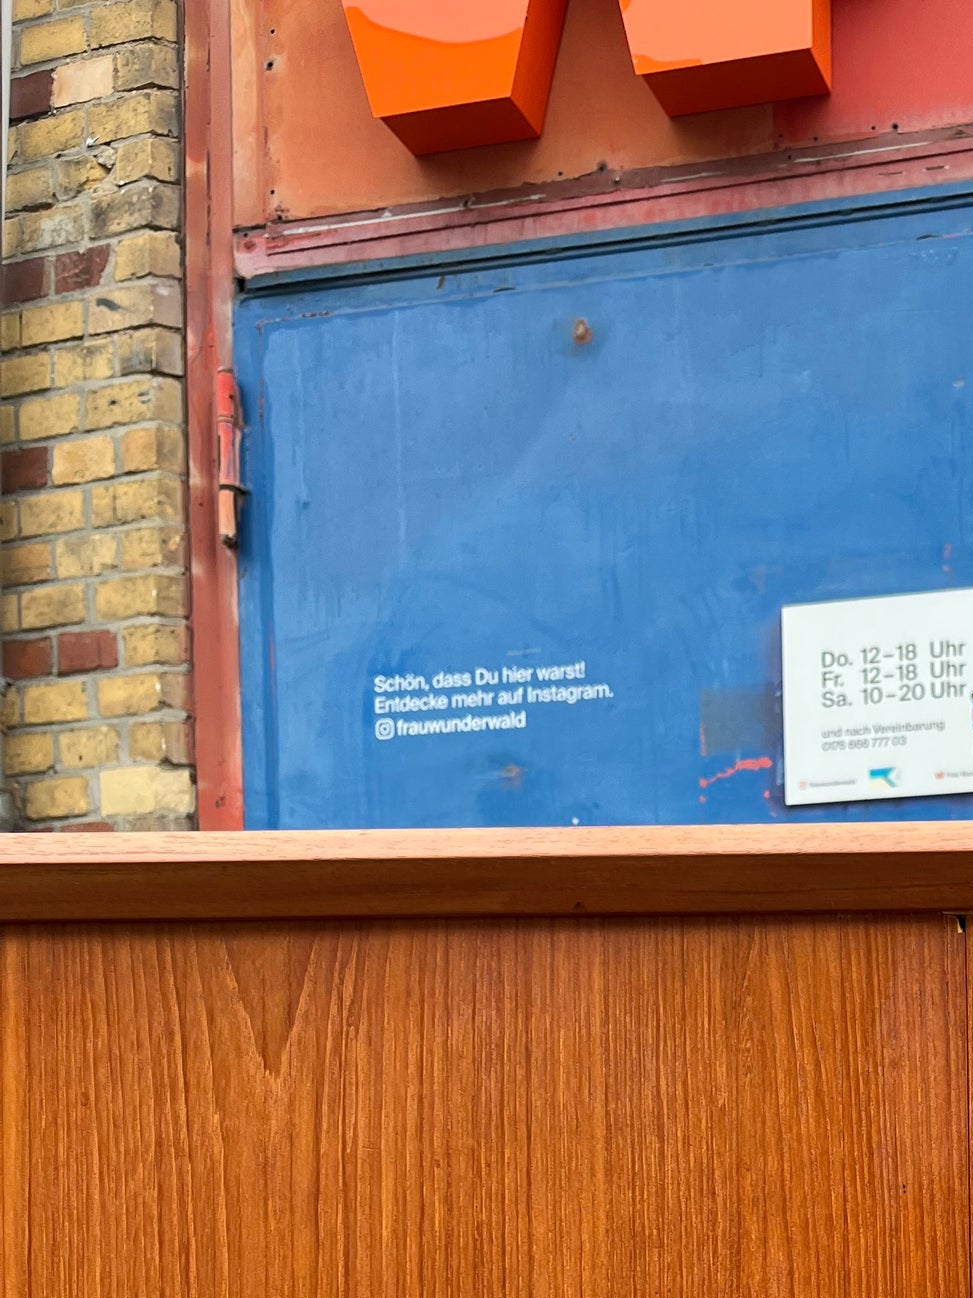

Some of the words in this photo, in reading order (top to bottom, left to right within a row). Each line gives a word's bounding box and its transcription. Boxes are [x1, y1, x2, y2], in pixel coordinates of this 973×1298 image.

[821, 651, 853, 668] Do.
[929, 640, 966, 659] Uhr
[373, 673, 429, 693] Schön,
[432, 671, 472, 689] dass
[475, 668, 498, 686] Du
[502, 665, 533, 684] hier
[536, 661, 586, 682] warst!
[821, 671, 845, 688] Fr.
[929, 661, 967, 678] Uhr
[374, 693, 448, 714] Entdecke
[451, 689, 493, 708] mehr
[497, 687, 524, 705] auf
[527, 683, 614, 704] Instagram.
[821, 691, 853, 708] Sa.
[929, 681, 967, 699] Uhr
[397, 710, 526, 736] frauwunderwald
[821, 727, 842, 738] und
[844, 725, 871, 737] nach
[872, 720, 946, 735] Vereinbarung
